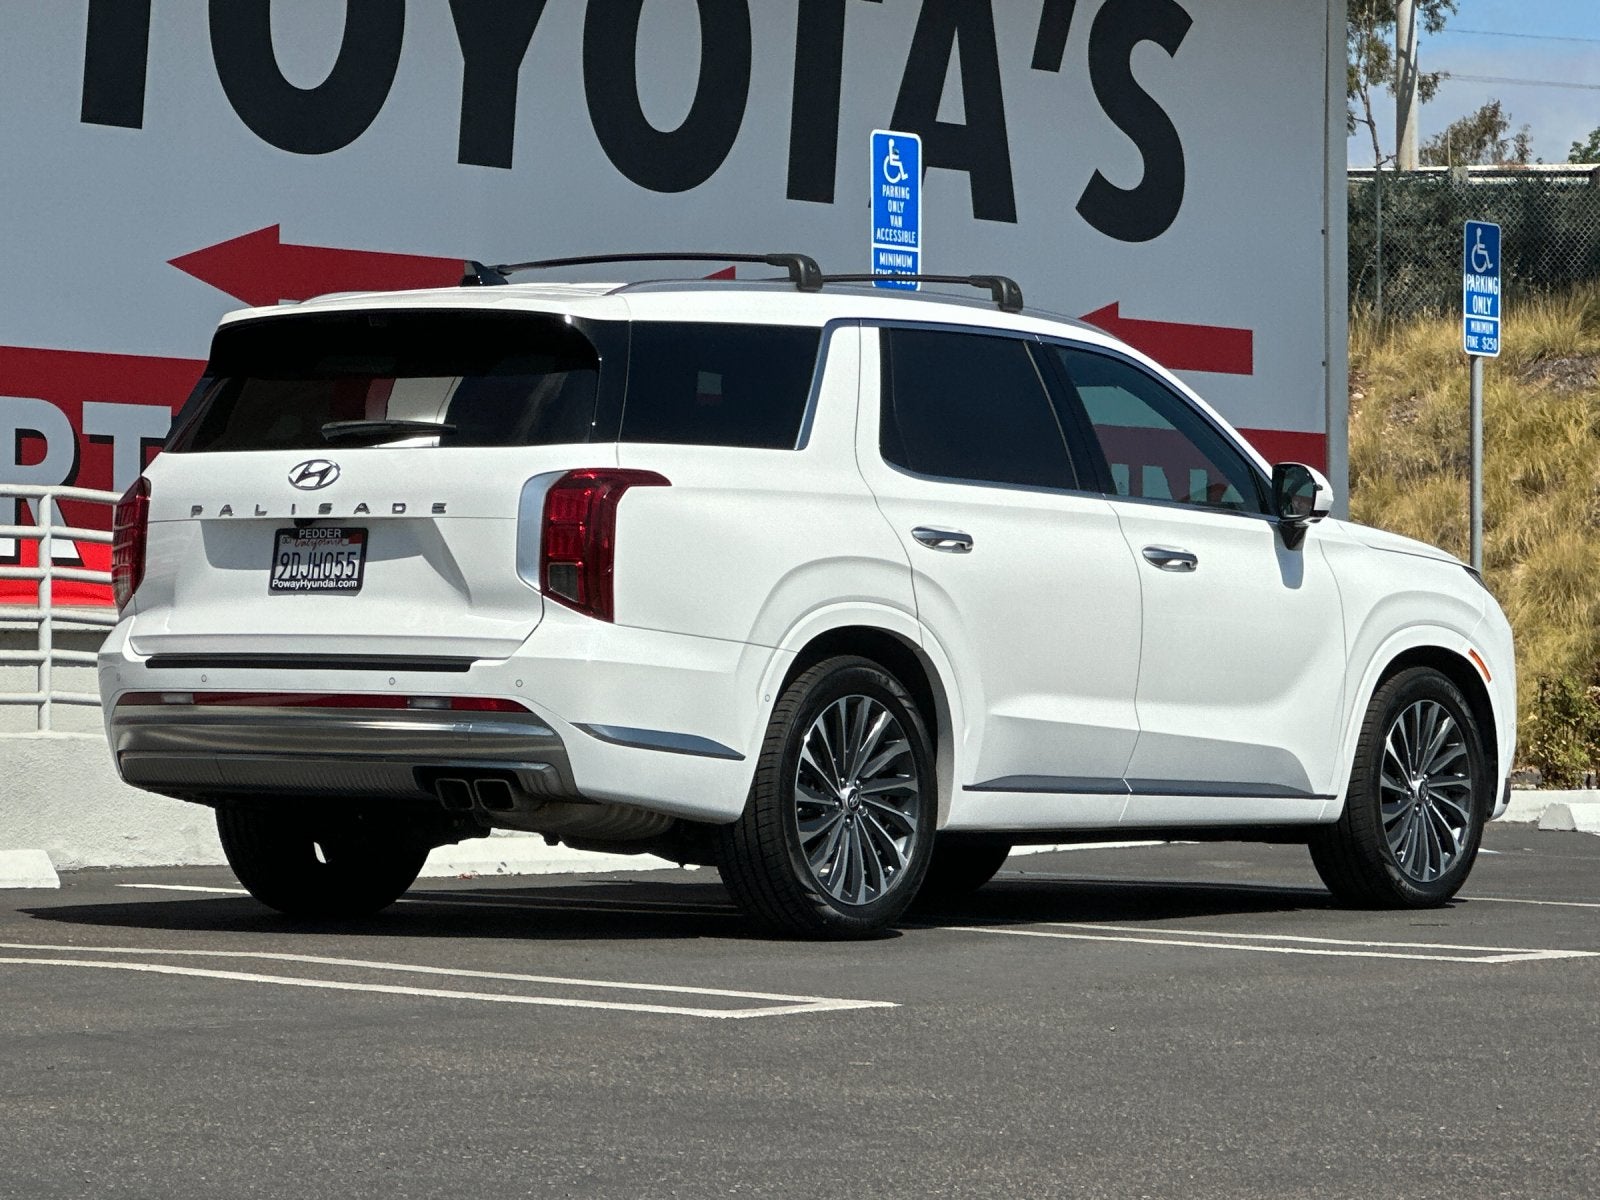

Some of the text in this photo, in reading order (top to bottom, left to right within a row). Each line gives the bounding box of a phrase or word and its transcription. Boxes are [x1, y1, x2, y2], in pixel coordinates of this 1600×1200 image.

[882, 184, 910, 200] PARKING
[887, 199, 905, 213] ONLY
[889, 215, 903, 228] VAN
[876, 228, 916, 244] ACCESSIBLE
[879, 252, 913, 268] MINIMUM
[1466, 273, 1498, 295] PARKING
[1472, 295, 1492, 315] ONLY
[1467, 335, 1497, 351] FINE $250
[190, 502, 447, 518] PALISADE
[299, 528, 341, 539] PEDDER
[278, 551, 357, 579] 9DJH055
[271, 580, 357, 590] PowayHyundai.com
